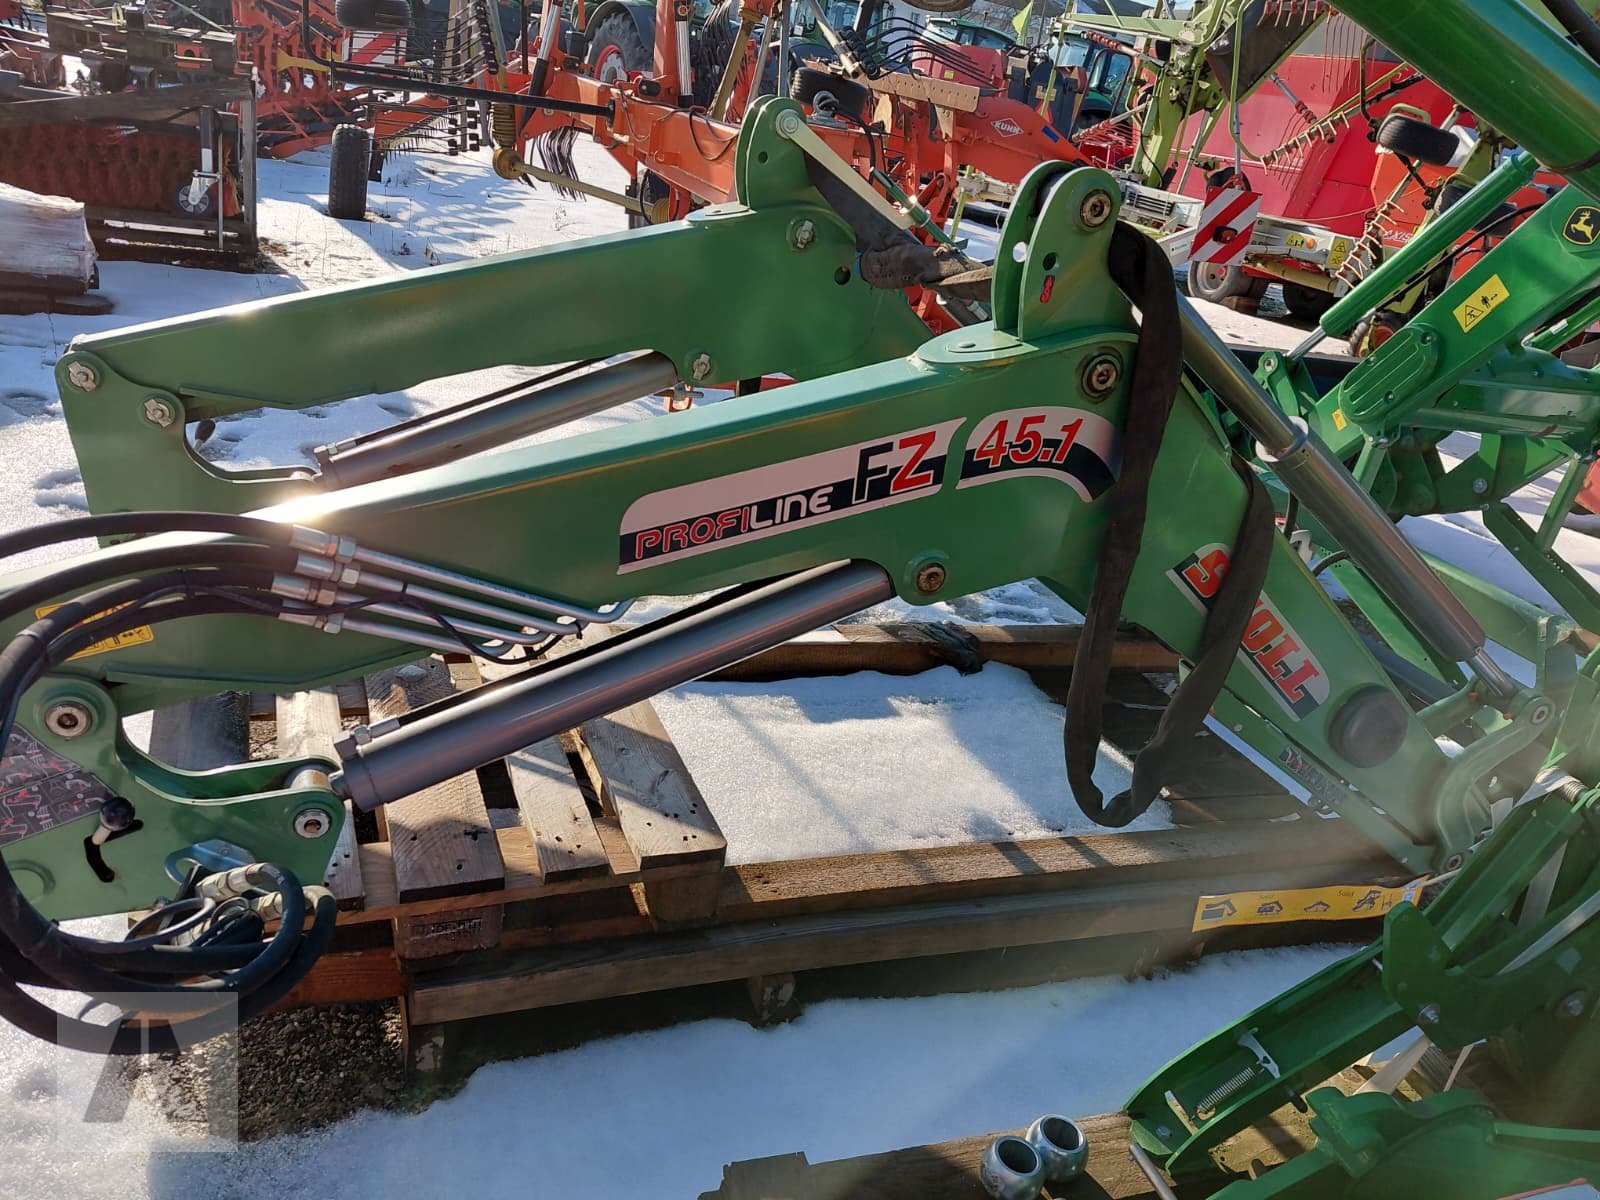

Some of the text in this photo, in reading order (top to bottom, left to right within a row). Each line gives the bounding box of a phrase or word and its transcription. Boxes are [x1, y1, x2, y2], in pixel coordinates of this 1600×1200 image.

[992, 121, 1020, 134] KUHN
[634, 414, 1084, 560] PROFILINE FZ 45.1
[1182, 548, 1320, 704] SOLL
